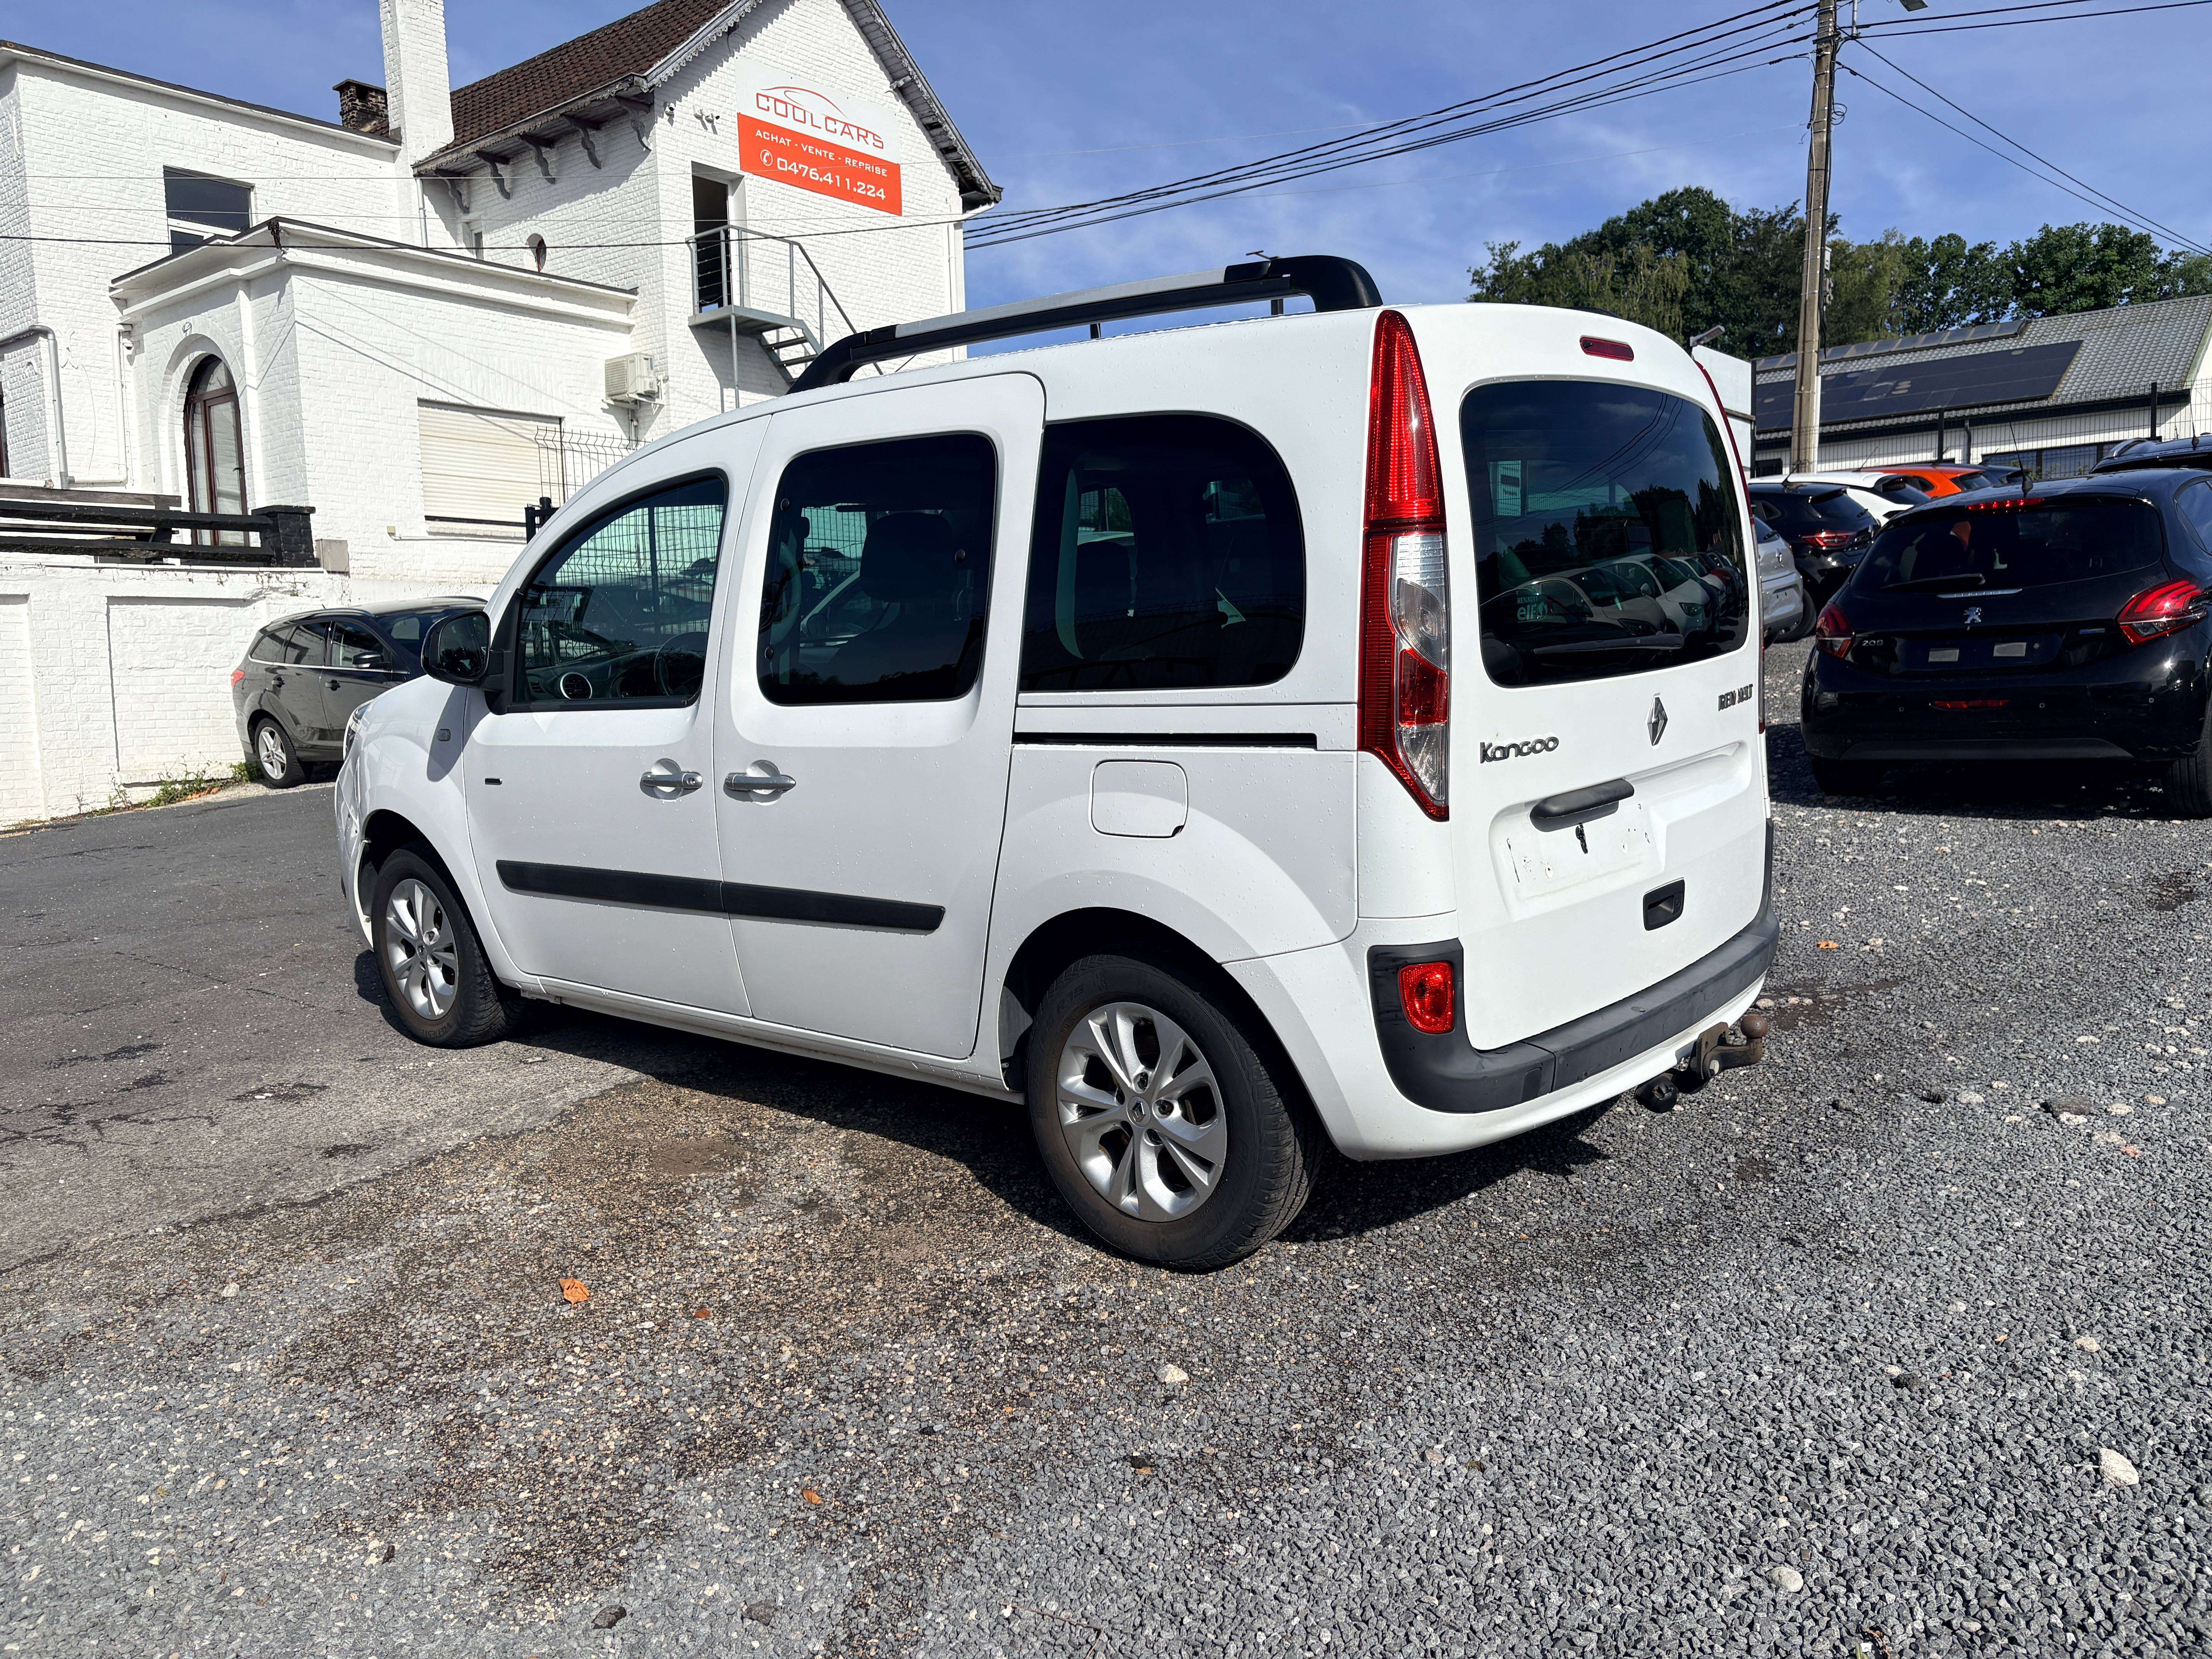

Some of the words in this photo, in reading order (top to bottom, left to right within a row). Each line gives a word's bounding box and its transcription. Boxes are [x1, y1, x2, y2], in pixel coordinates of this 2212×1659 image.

[756, 93, 884, 149] COOLCARS
[756, 129, 792, 146] ACHAT
[801, 143, 835, 161] VENTE
[845, 156, 888, 177] REPRISE
[777, 157, 886, 200] 0476.411.224
[1518, 605, 1536, 620] elf
[1480, 736, 1559, 764] Kangoo
